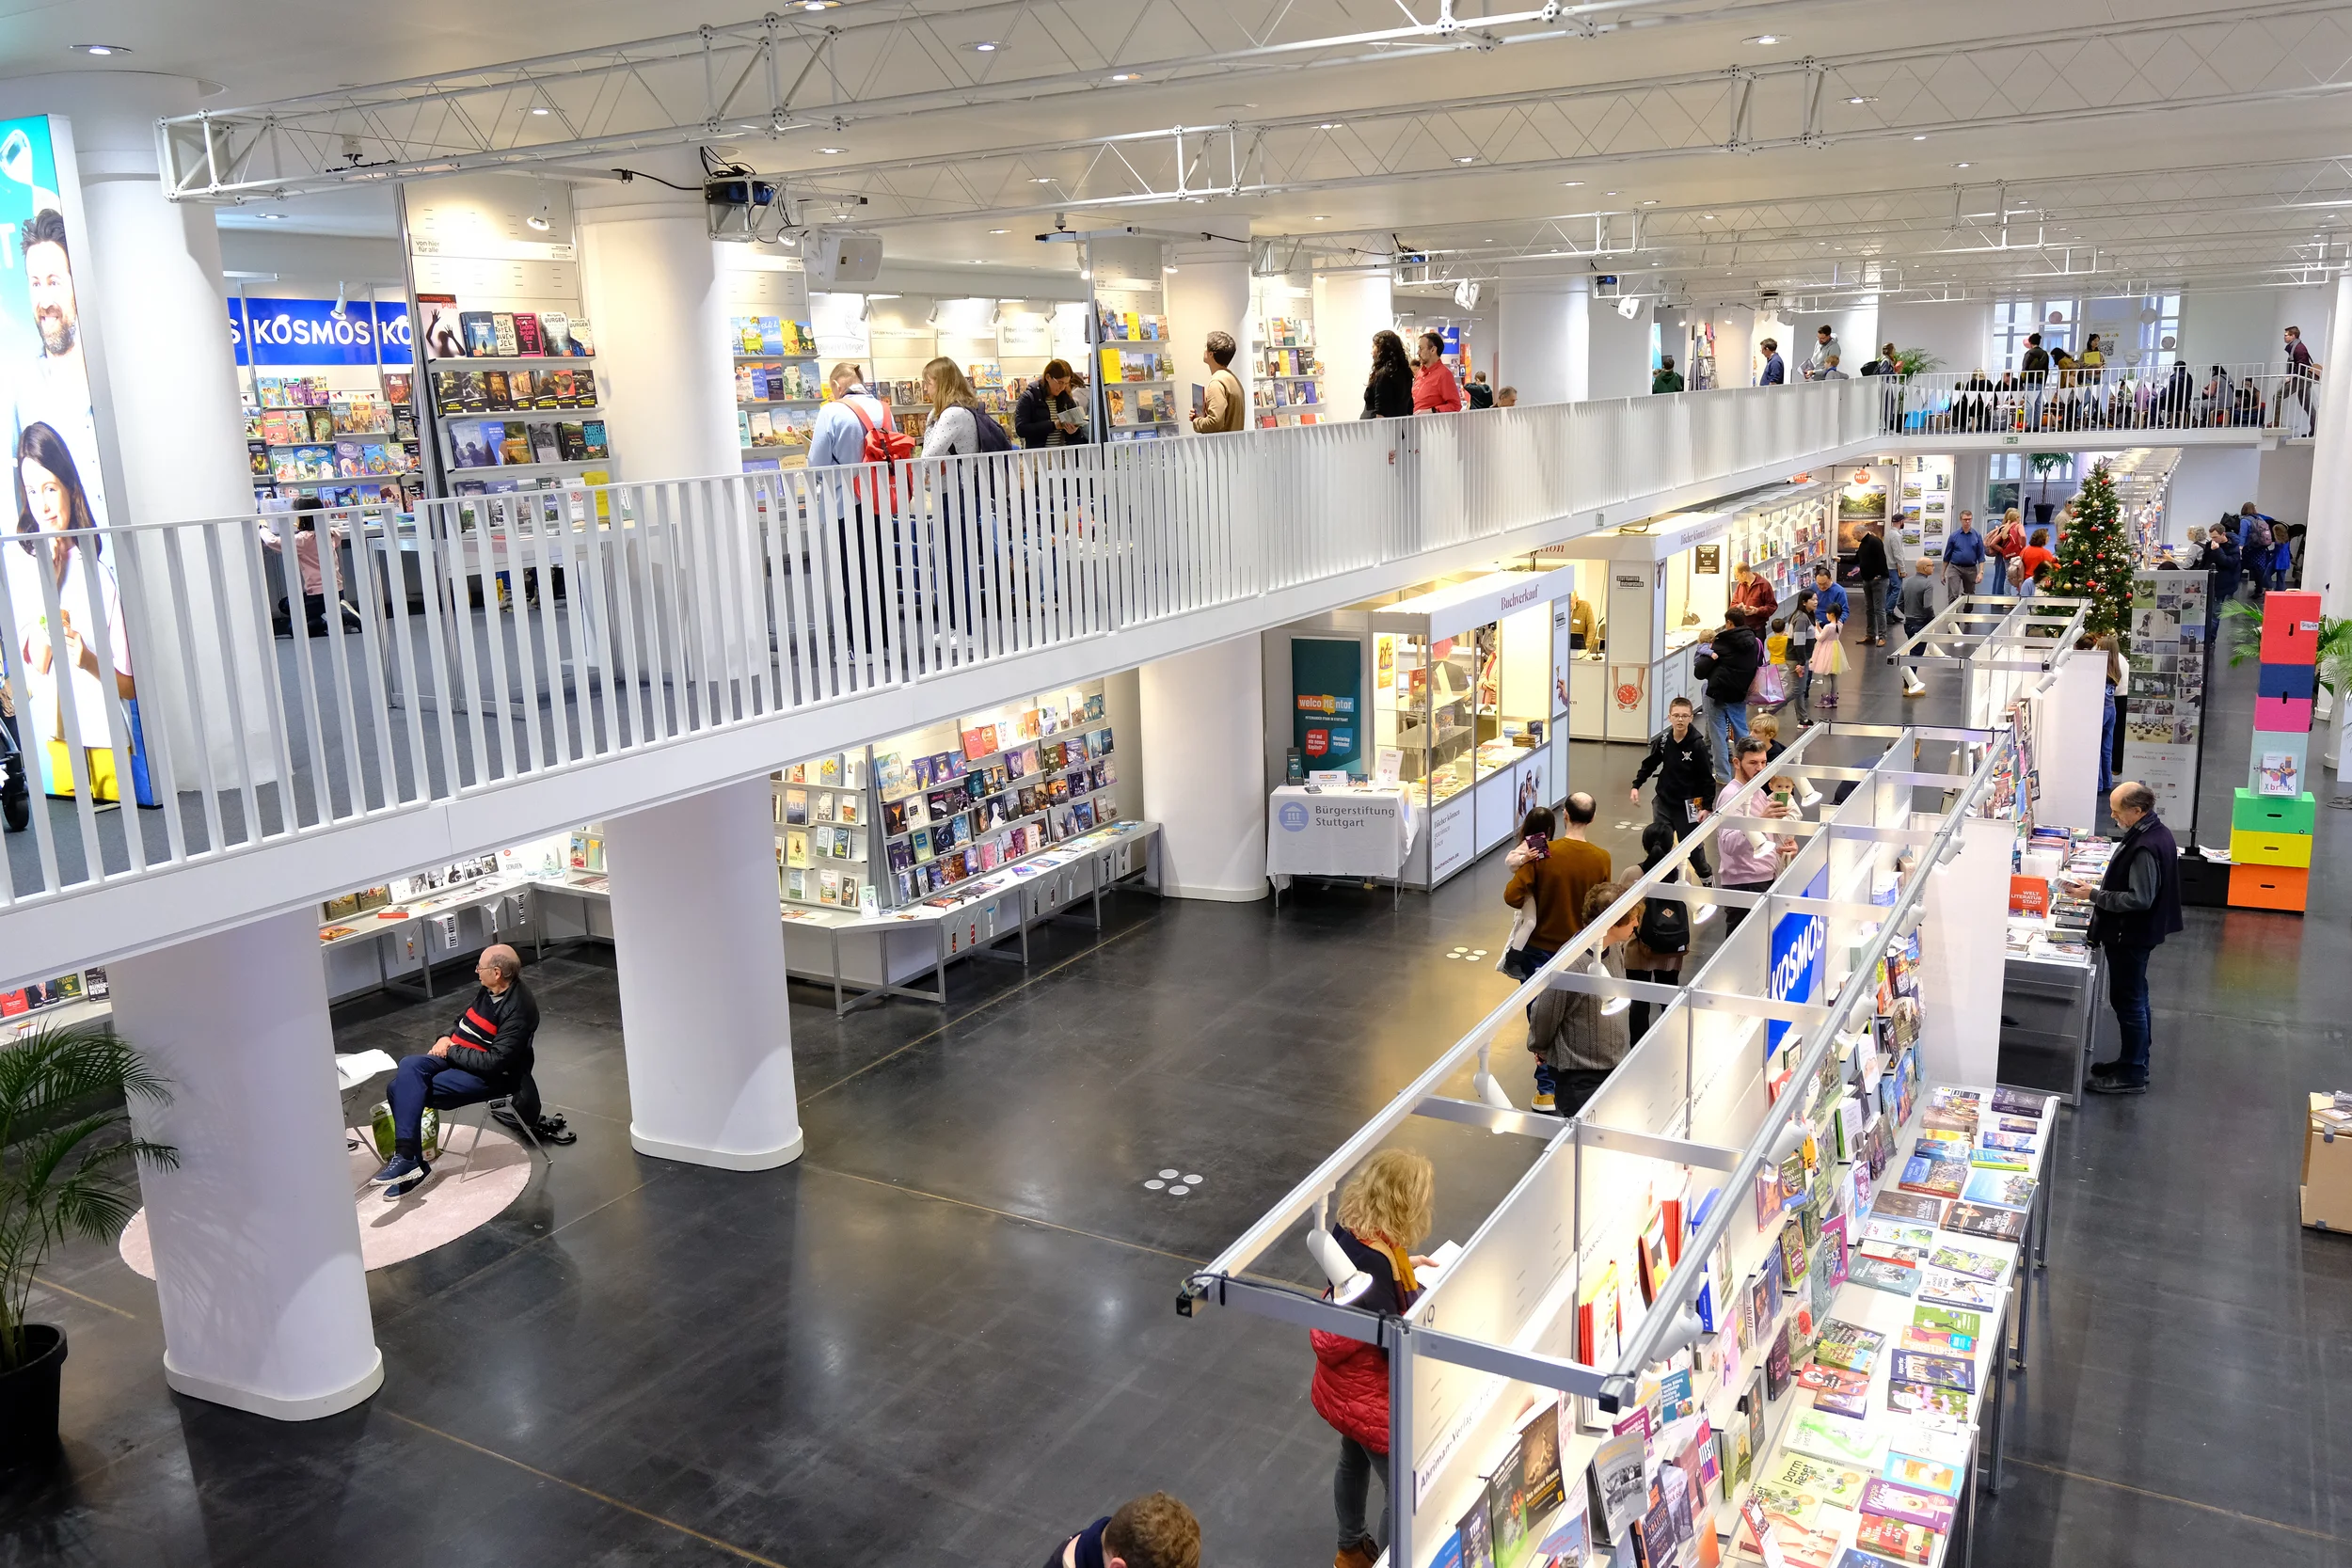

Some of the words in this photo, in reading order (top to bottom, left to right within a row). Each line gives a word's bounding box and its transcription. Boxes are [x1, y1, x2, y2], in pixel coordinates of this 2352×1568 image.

[253, 319, 371, 345] KOSMOS
[1501, 583, 1539, 610] Buchverkauf
[788, 800, 804, 811] ALB
[1315, 805, 1395, 817] Bürgerstiftung
[1315, 817, 1365, 829] Stuttgart
[1771, 915, 1824, 1001] KOSMOS
[89, 988, 106, 996] WEHR
[1421, 1416, 1473, 1491] Ahriman-Verlag
[1782, 1460, 1803, 1483] Darm
[1794, 1464, 1814, 1486] Reset
[1470, 1516, 1482, 1538] TTIP
[1647, 1508, 1667, 1534] POLITIK
[1883, 1522, 1894, 1537] denn
[1861, 1527, 1871, 1538] Was
[1870, 1524, 1882, 1542] blüht
[1892, 1527, 1903, 1540] da?
